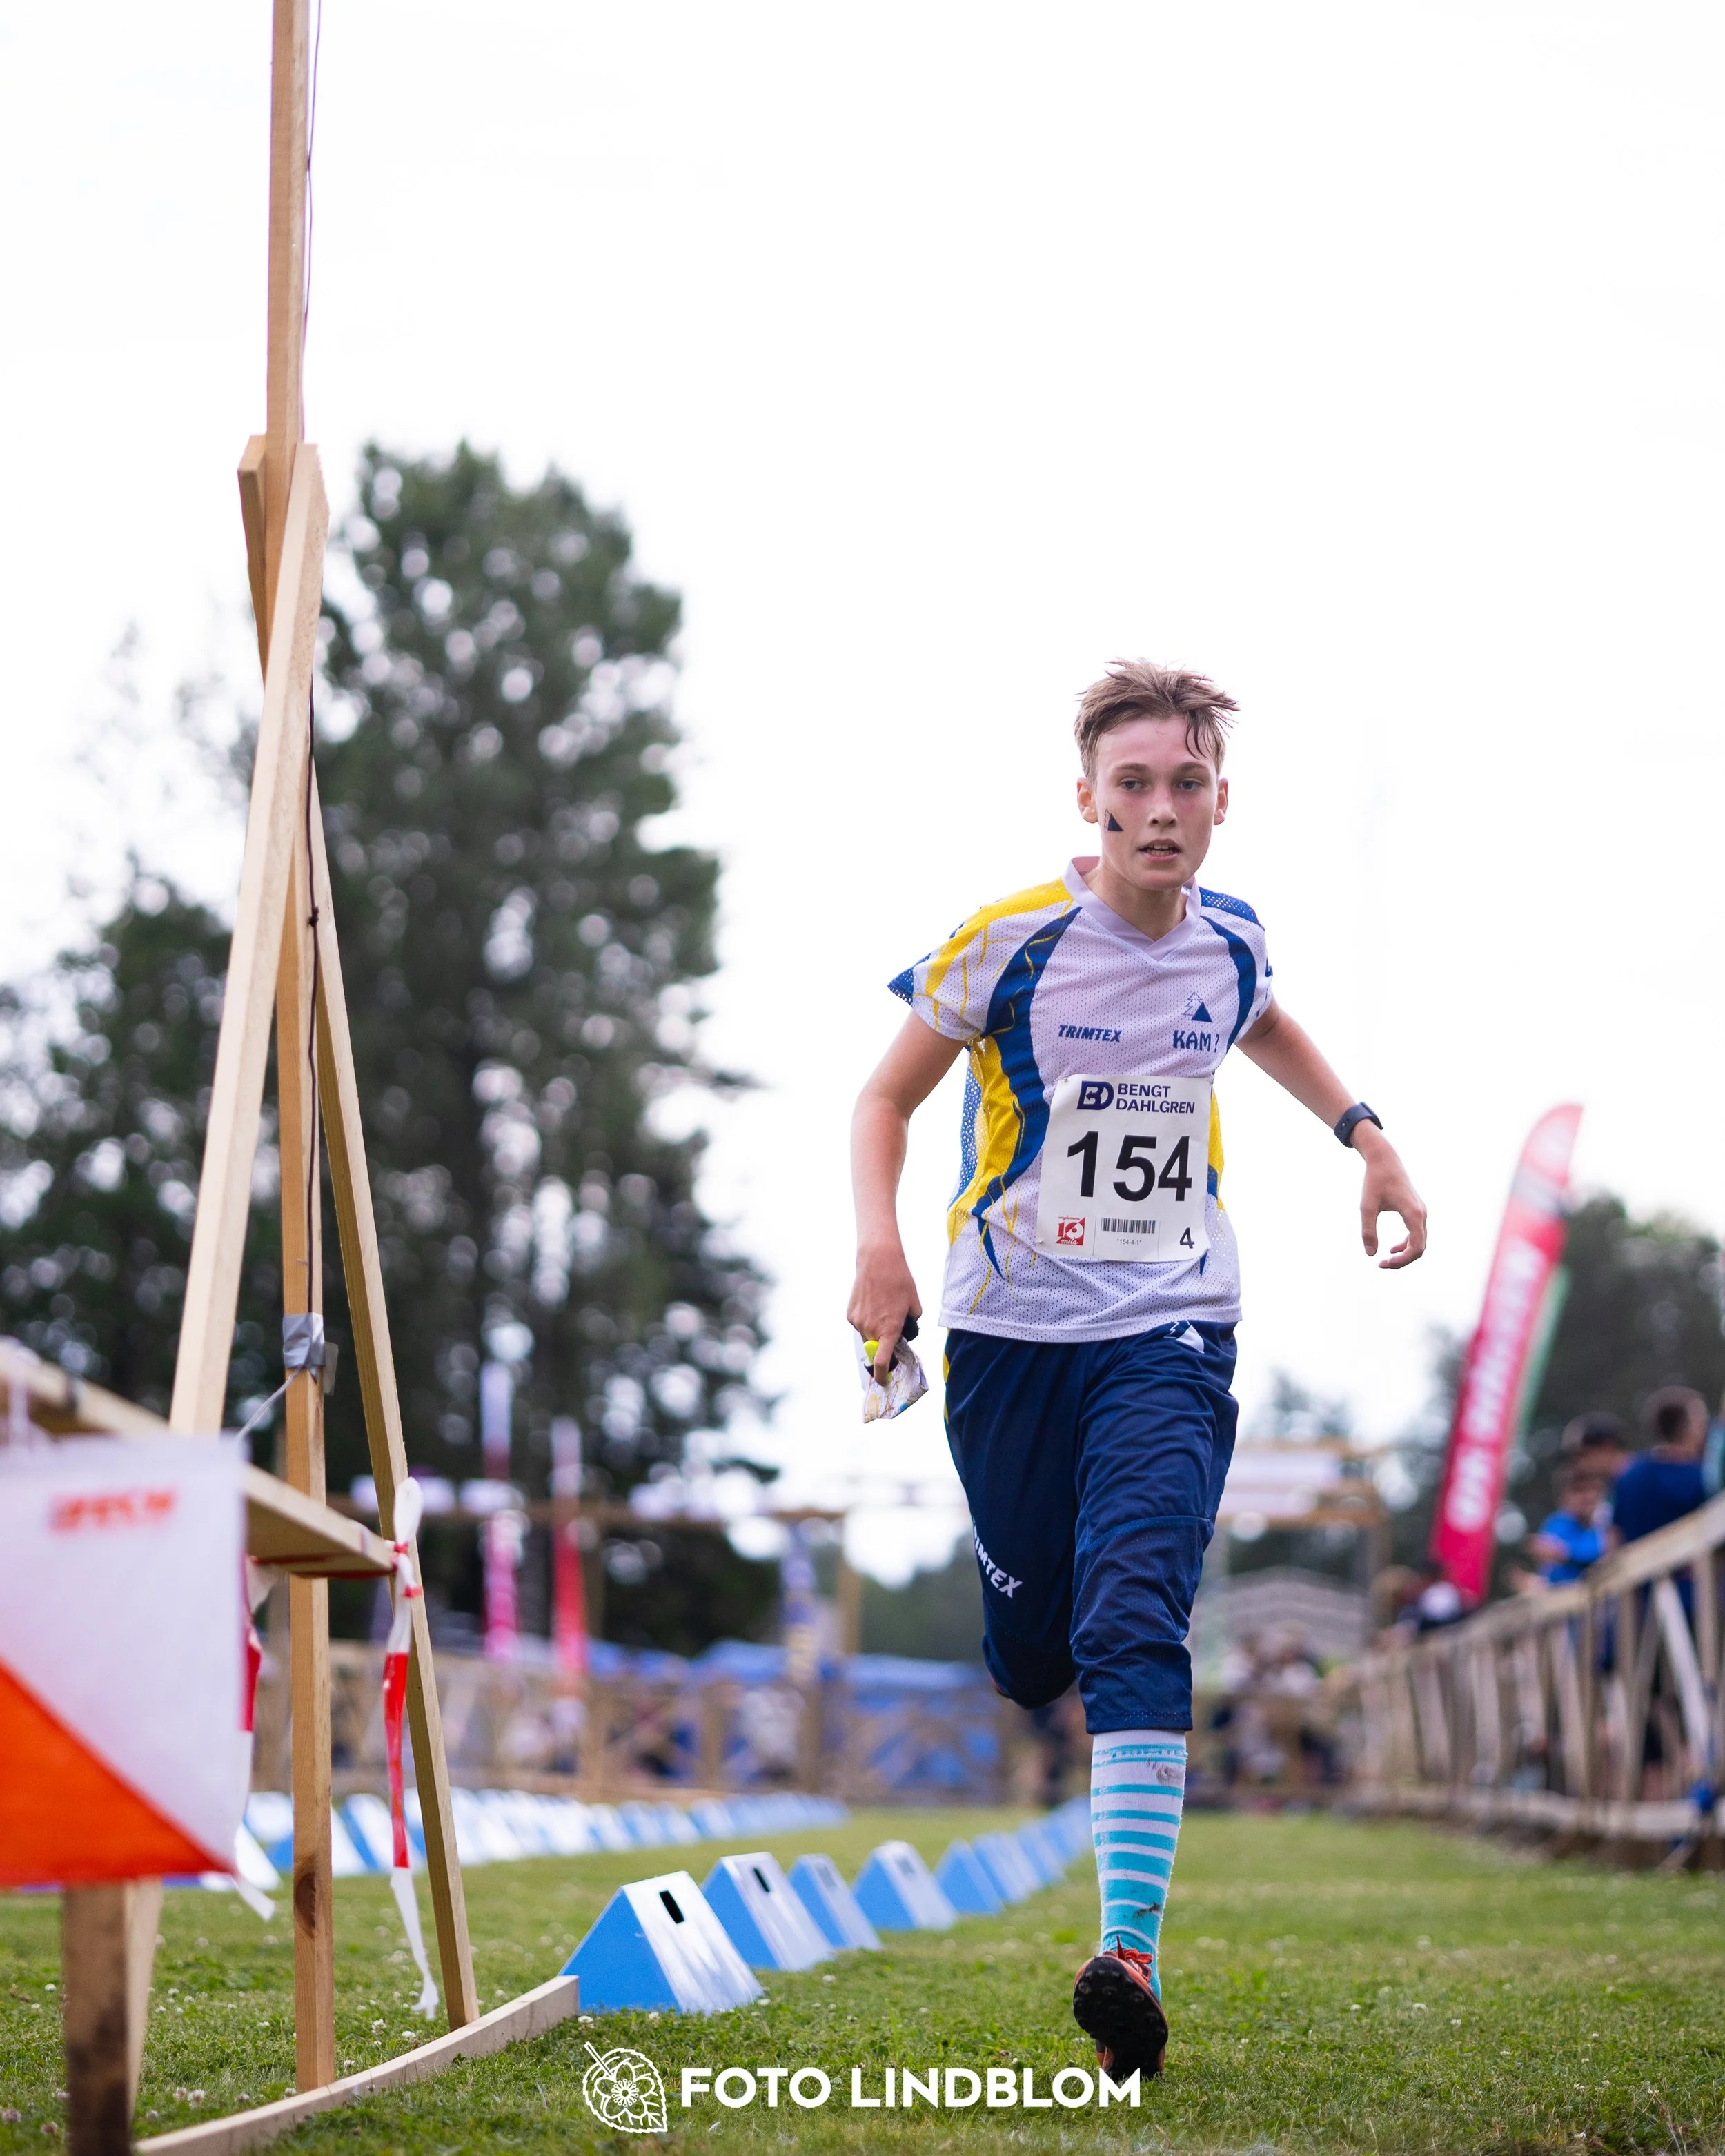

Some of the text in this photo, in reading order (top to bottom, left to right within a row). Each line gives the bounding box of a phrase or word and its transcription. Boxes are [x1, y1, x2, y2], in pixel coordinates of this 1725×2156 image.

[1058, 1024, 1123, 1042] TRIMTEX
[1117, 1083, 1171, 1098] BENGT
[1116, 1098, 1195, 1114] DAHLGREN
[1067, 1131, 1192, 1202] 154
[1179, 1227, 1195, 1249] 4
